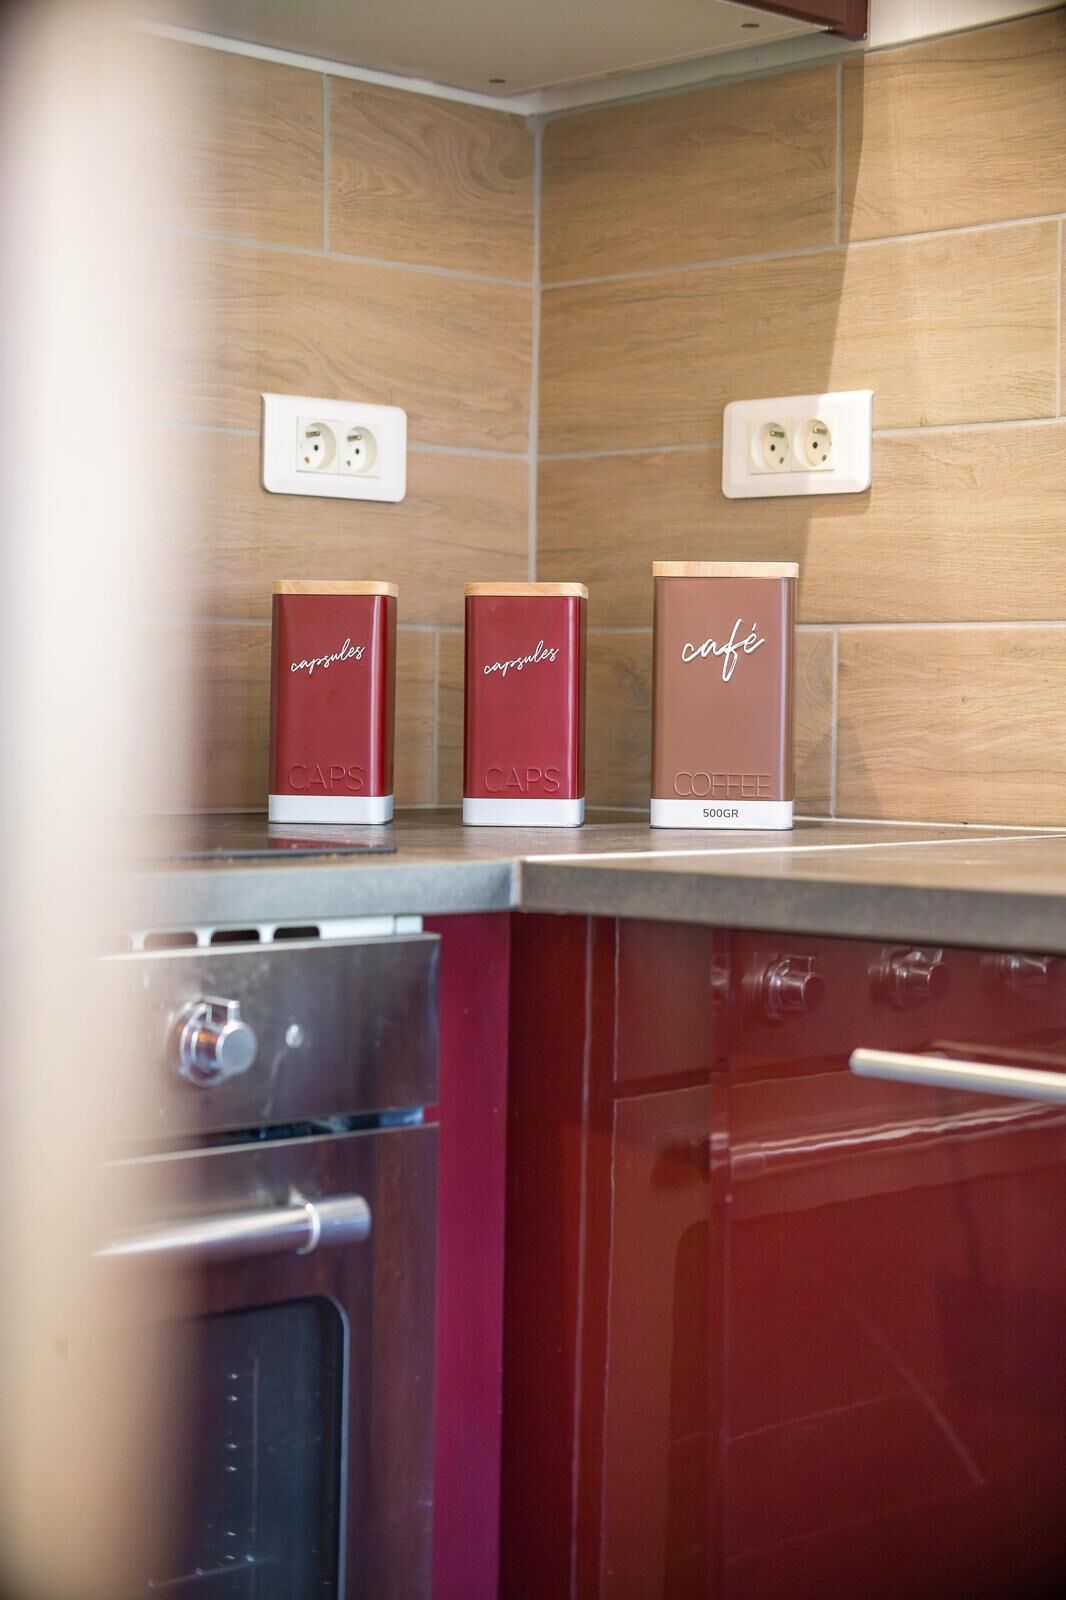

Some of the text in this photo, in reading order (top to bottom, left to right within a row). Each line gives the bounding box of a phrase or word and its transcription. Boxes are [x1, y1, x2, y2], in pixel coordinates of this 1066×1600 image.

[290, 638, 366, 676] capsules
[483, 640, 559, 677] capsules
[681, 618, 765, 682] café
[288, 765, 364, 792] CAPS
[484, 766, 560, 793] CAPS
[673, 771, 773, 799] COFFEE
[702, 808, 739, 819] 500GR
